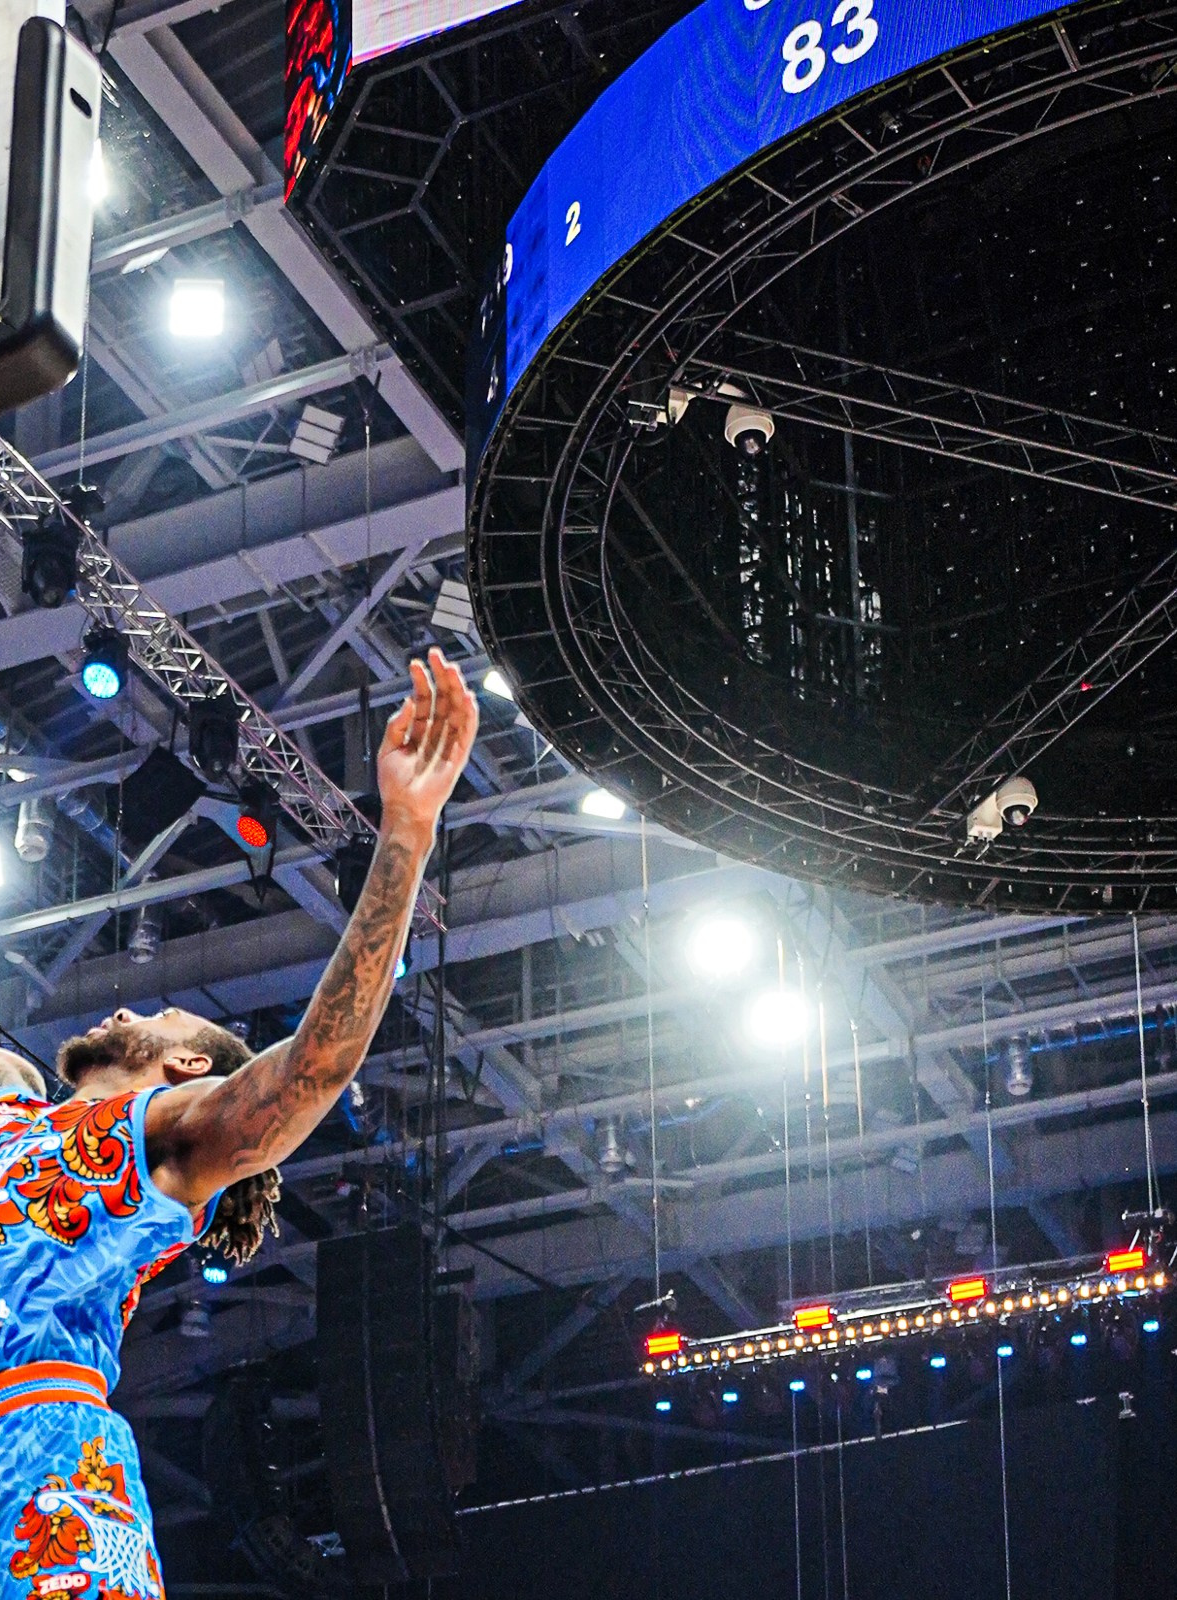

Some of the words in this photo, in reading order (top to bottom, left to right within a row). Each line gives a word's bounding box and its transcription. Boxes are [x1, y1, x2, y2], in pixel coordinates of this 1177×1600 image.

[782, 0, 879, 94] 83
[565, 202, 581, 247] 2
[39, 1573, 87, 1596] ZEDO
